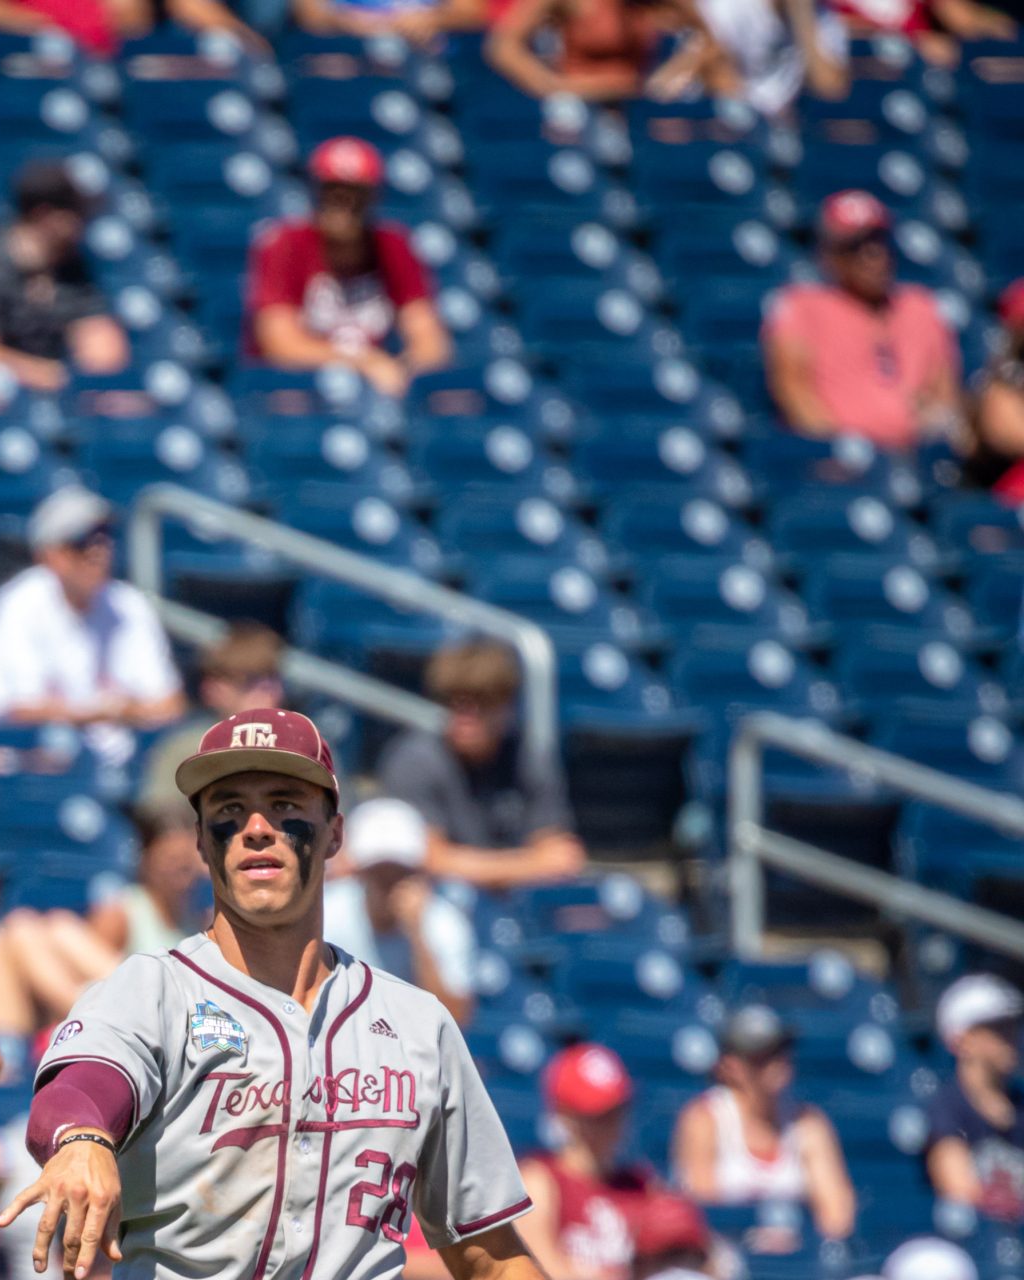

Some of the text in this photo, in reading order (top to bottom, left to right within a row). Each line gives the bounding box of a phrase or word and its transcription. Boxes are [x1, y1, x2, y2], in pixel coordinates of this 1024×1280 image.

[199, 1065, 420, 1135] Texas A&M
[346, 1148, 418, 1244] 28
